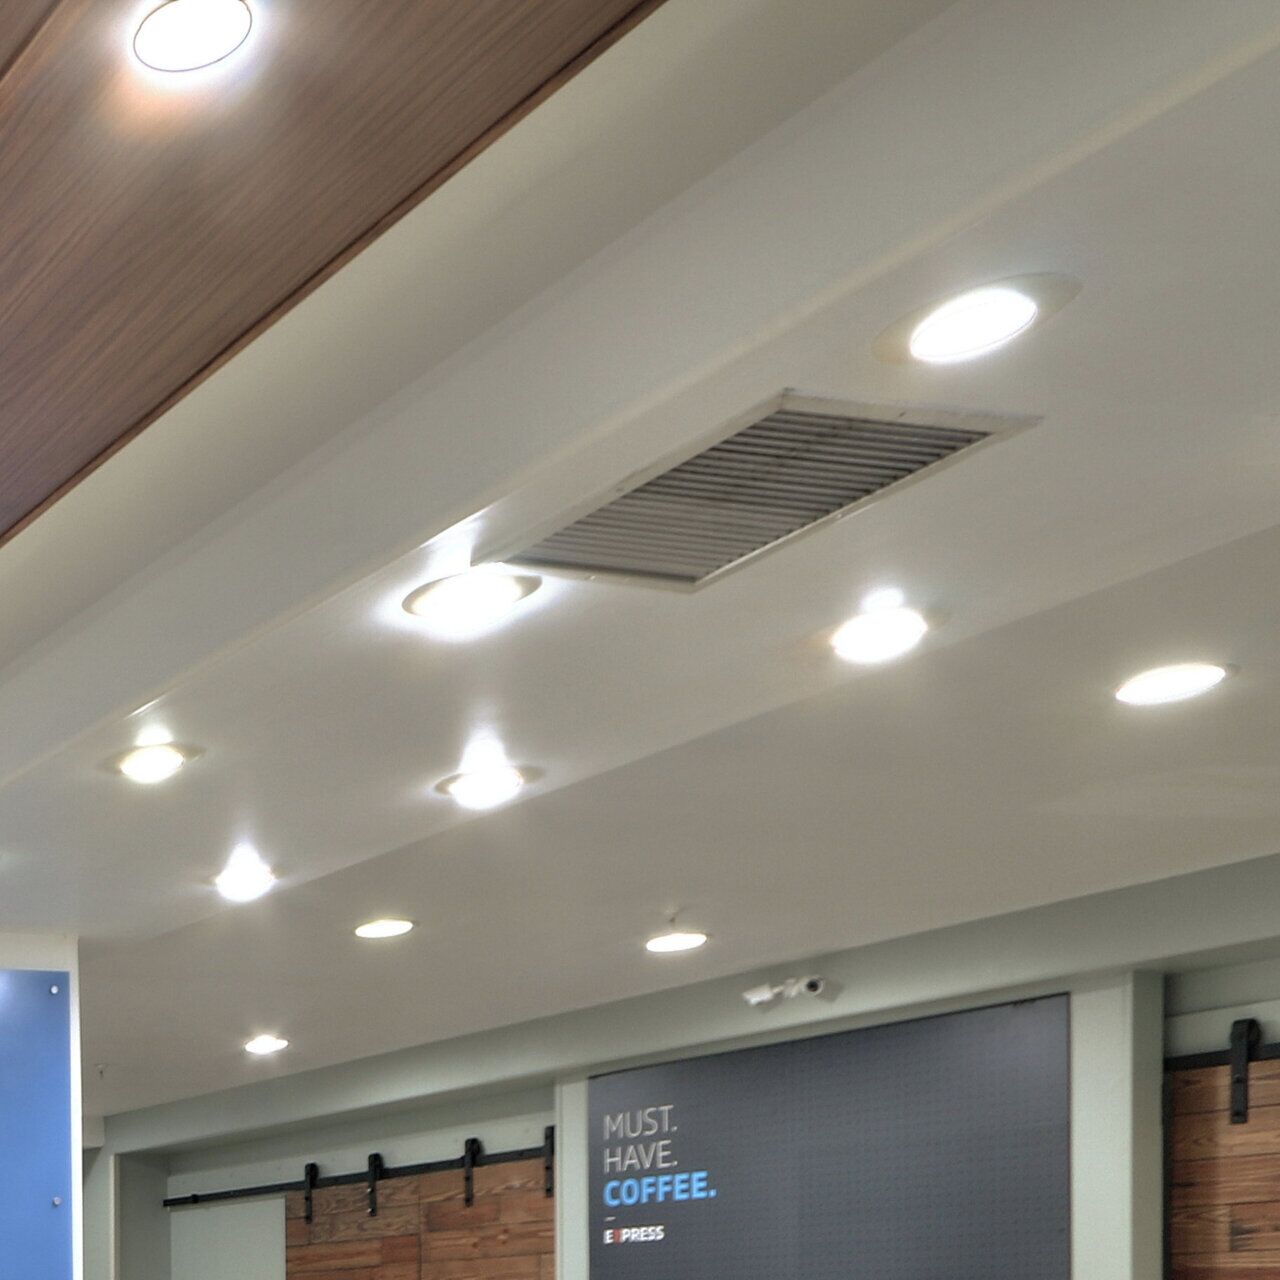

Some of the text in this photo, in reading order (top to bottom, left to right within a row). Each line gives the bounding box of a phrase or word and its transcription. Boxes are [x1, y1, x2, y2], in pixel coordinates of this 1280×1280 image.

[603, 1104, 678, 1140] MUST.
[603, 1139, 678, 1174] HAVE.
[603, 1170, 717, 1208] COFFEE.
